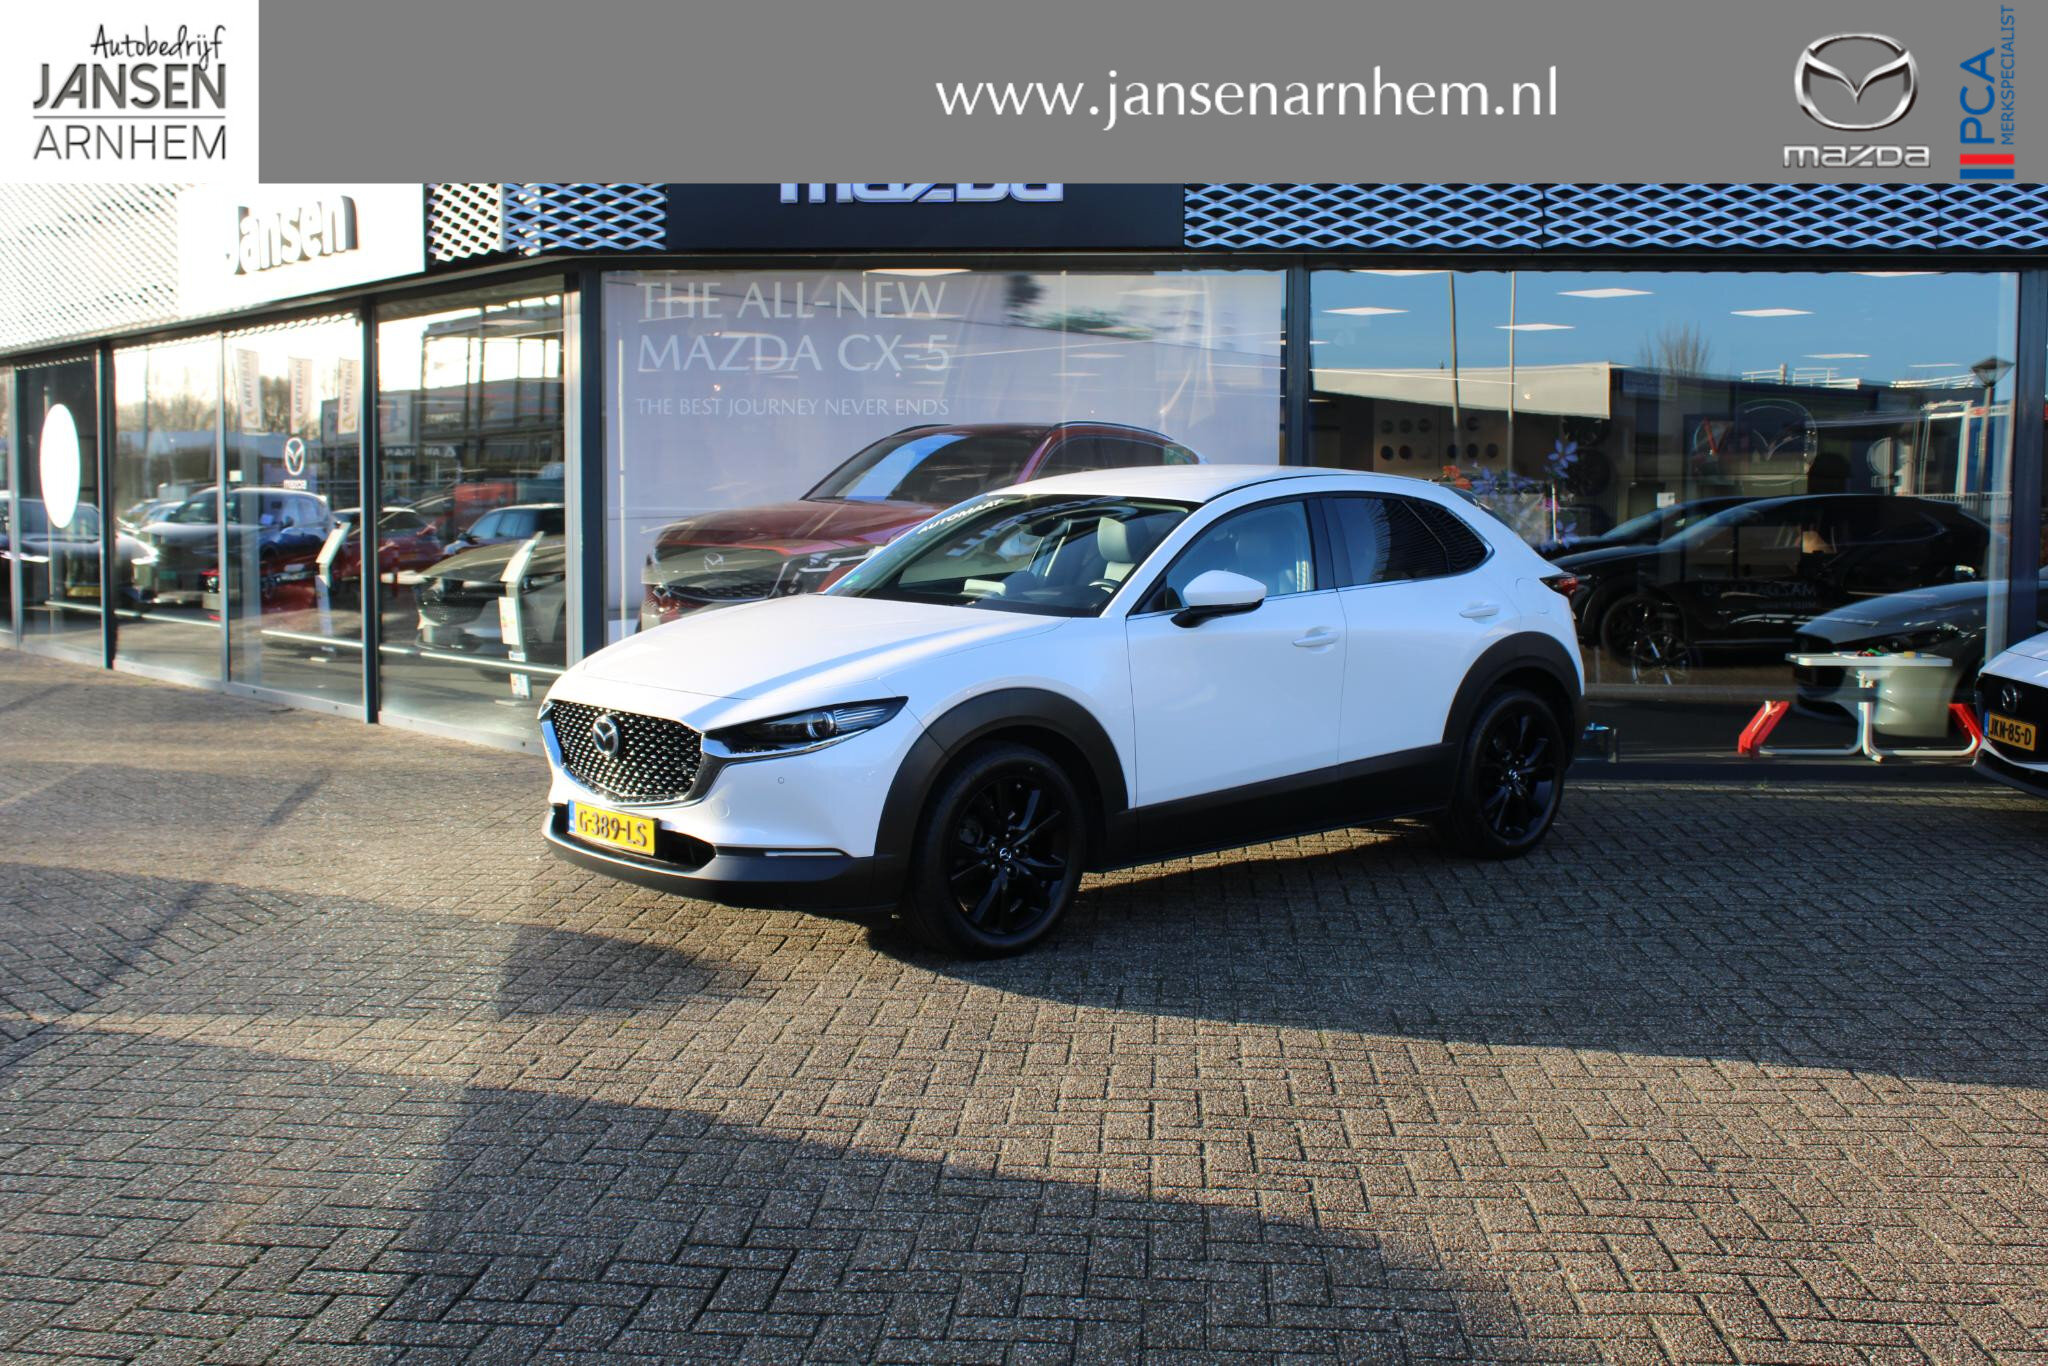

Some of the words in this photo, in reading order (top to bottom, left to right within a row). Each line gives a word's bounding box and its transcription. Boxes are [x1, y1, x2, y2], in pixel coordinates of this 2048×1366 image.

[636, 282, 723, 319] THE
[736, 281, 946, 319] ALL-NEW
[638, 334, 823, 371] MAZDA
[838, 334, 948, 371] CX-5
[637, 399, 672, 415] THE
[680, 399, 722, 415] BEST
[728, 399, 819, 418] JOURNEY
[825, 399, 889, 415] NEVER
[896, 399, 949, 415] ENDS
[579, 810, 647, 847] G-389-LS
